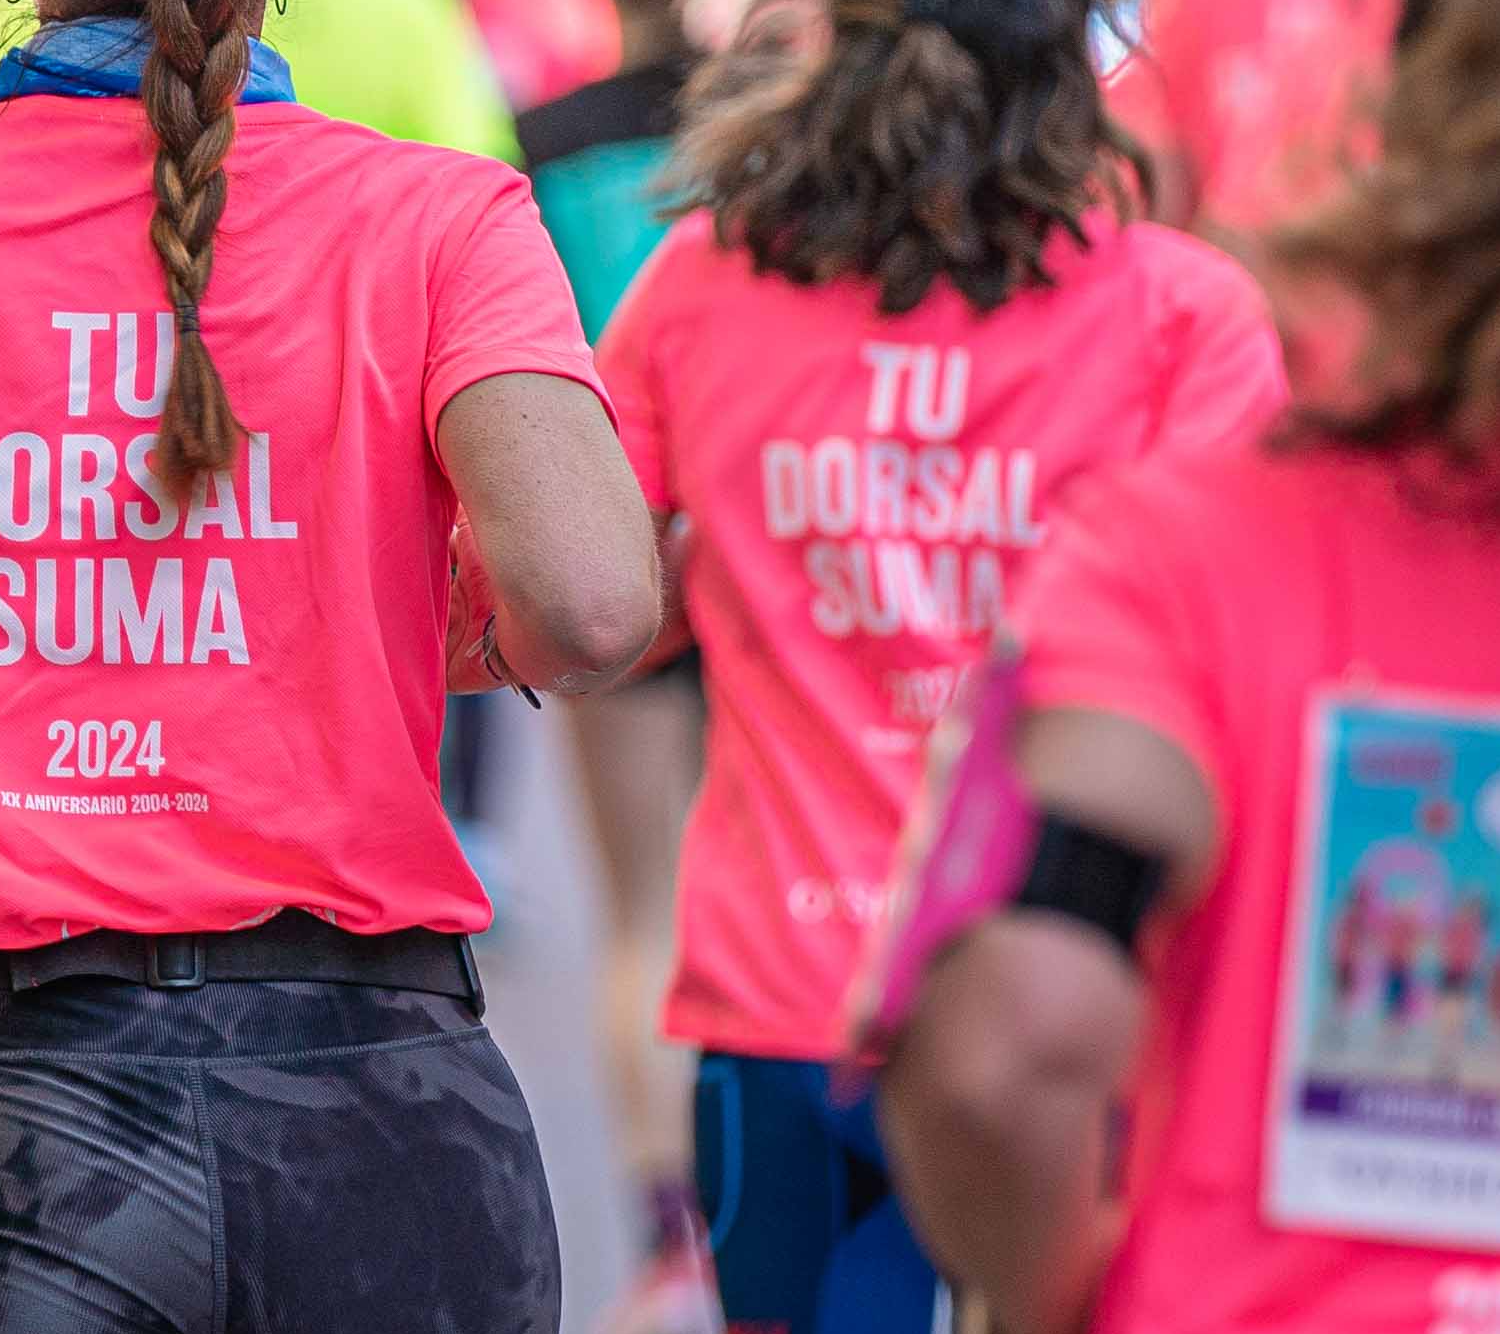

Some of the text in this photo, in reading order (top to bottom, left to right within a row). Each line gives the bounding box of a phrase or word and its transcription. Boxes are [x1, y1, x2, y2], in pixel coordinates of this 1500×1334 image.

[51, 311, 175, 418] TU
[861, 341, 972, 440] TU
[760, 436, 1047, 547] DORSAL
[46, 719, 166, 779] 2024
[1, 791, 209, 815] XX ANIVERSARIO 2004-2024
